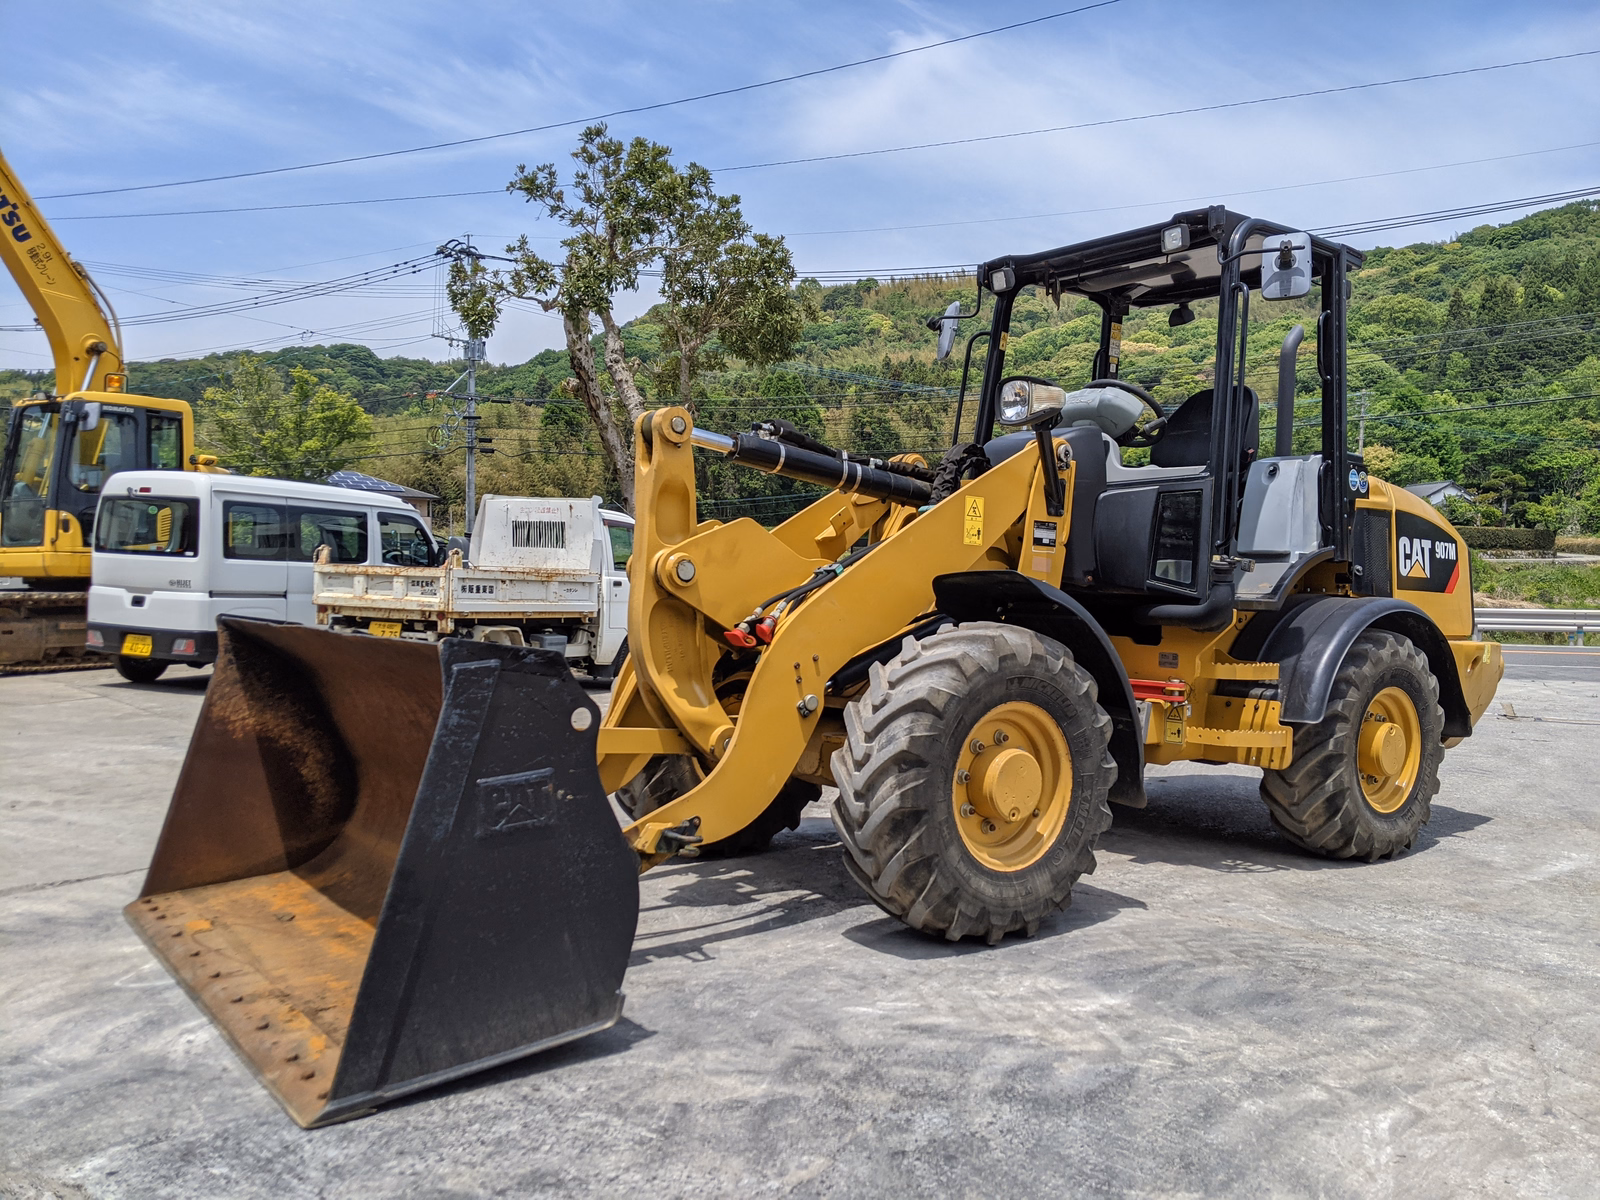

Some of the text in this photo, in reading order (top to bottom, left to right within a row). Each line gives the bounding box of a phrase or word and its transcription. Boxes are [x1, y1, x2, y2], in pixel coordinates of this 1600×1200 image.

[0, 187, 32, 243] TSU
[1398, 536, 1457, 578] CAT 907M
